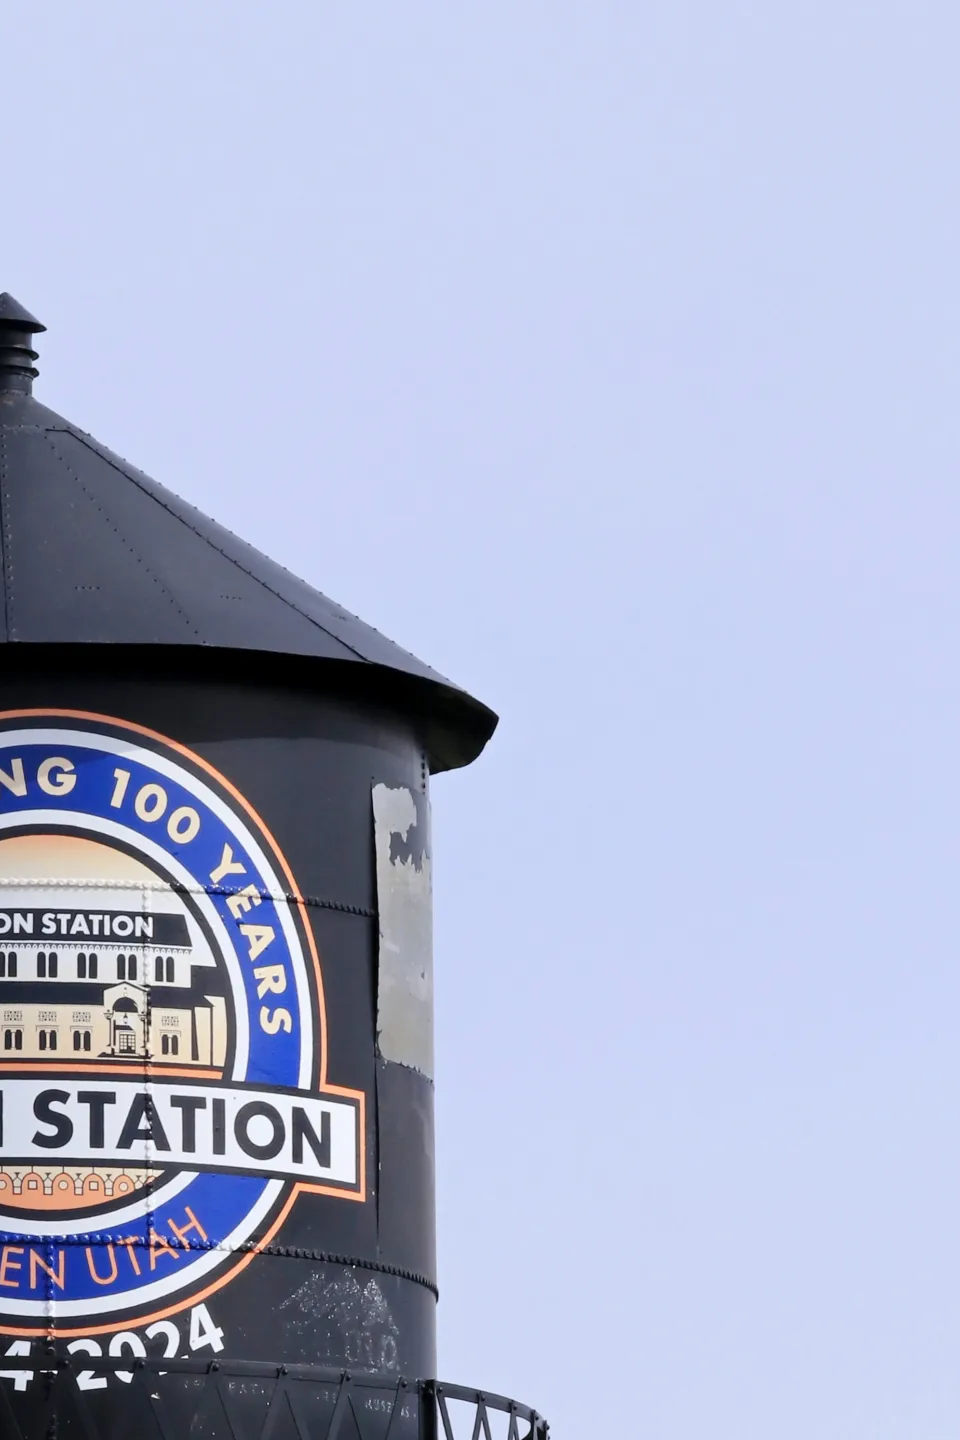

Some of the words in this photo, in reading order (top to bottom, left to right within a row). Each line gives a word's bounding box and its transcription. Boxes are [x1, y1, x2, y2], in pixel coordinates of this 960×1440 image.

[40, 912, 154, 938] STATION
[109, 768, 200, 844] 100
[209, 844, 292, 1036] YEARS
[31, 1088, 332, 1170] STATION
[89, 1206, 208, 1285] UTAH
